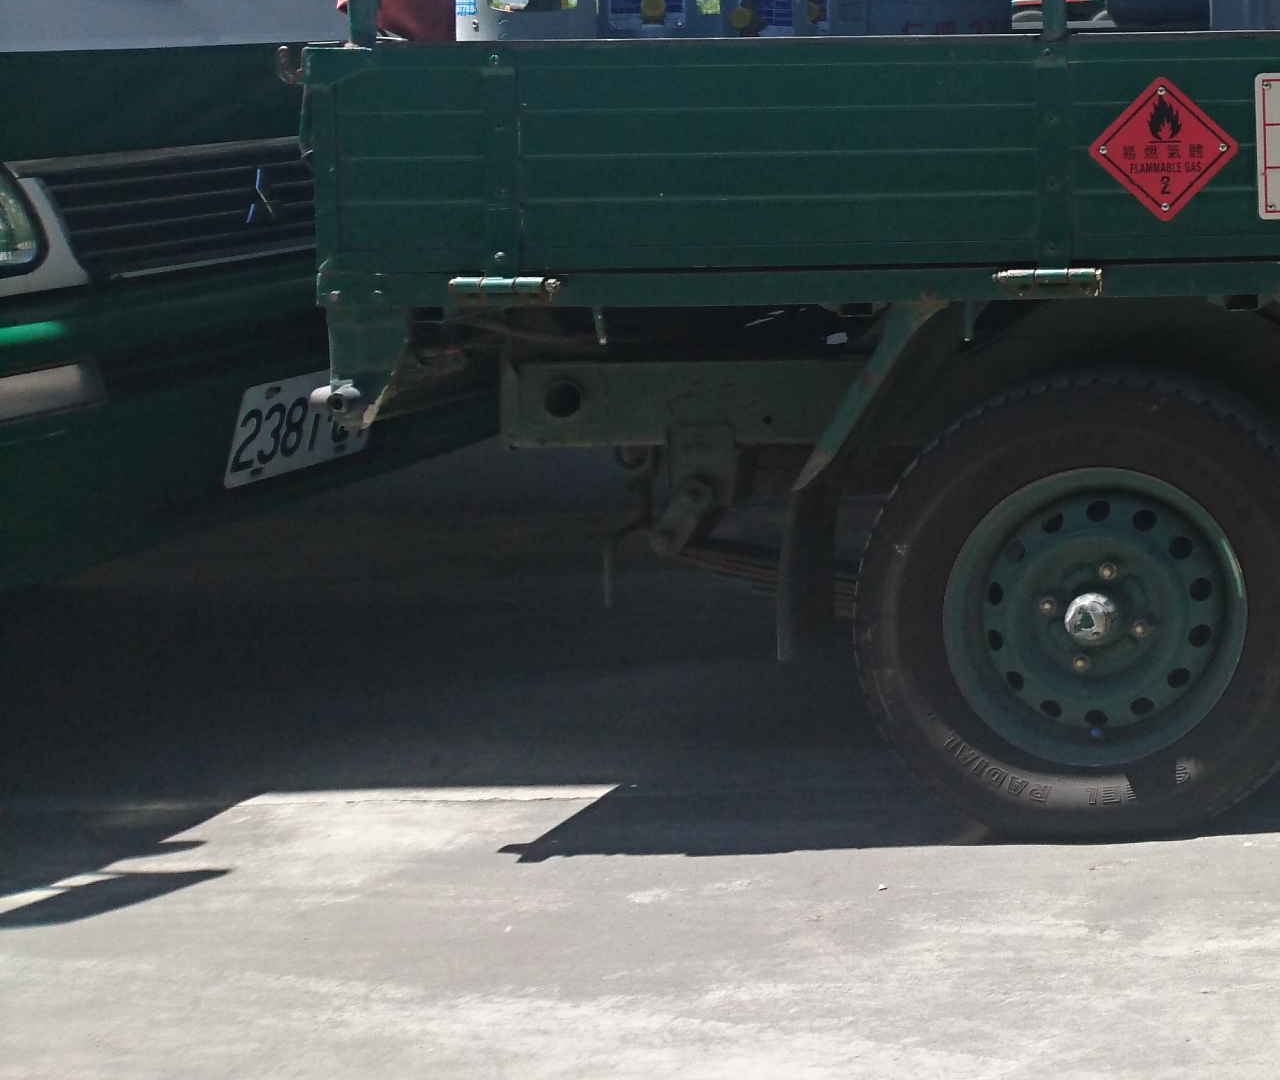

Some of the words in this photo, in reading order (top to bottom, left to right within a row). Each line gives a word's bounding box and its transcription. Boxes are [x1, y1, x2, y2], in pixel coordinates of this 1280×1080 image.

[1122, 143, 1204, 160] 易燃氣體
[1130, 162, 1182, 174] FLAMMABLE
[1184, 161, 1202, 173] GAS
[1160, 175, 1171, 195] 2
